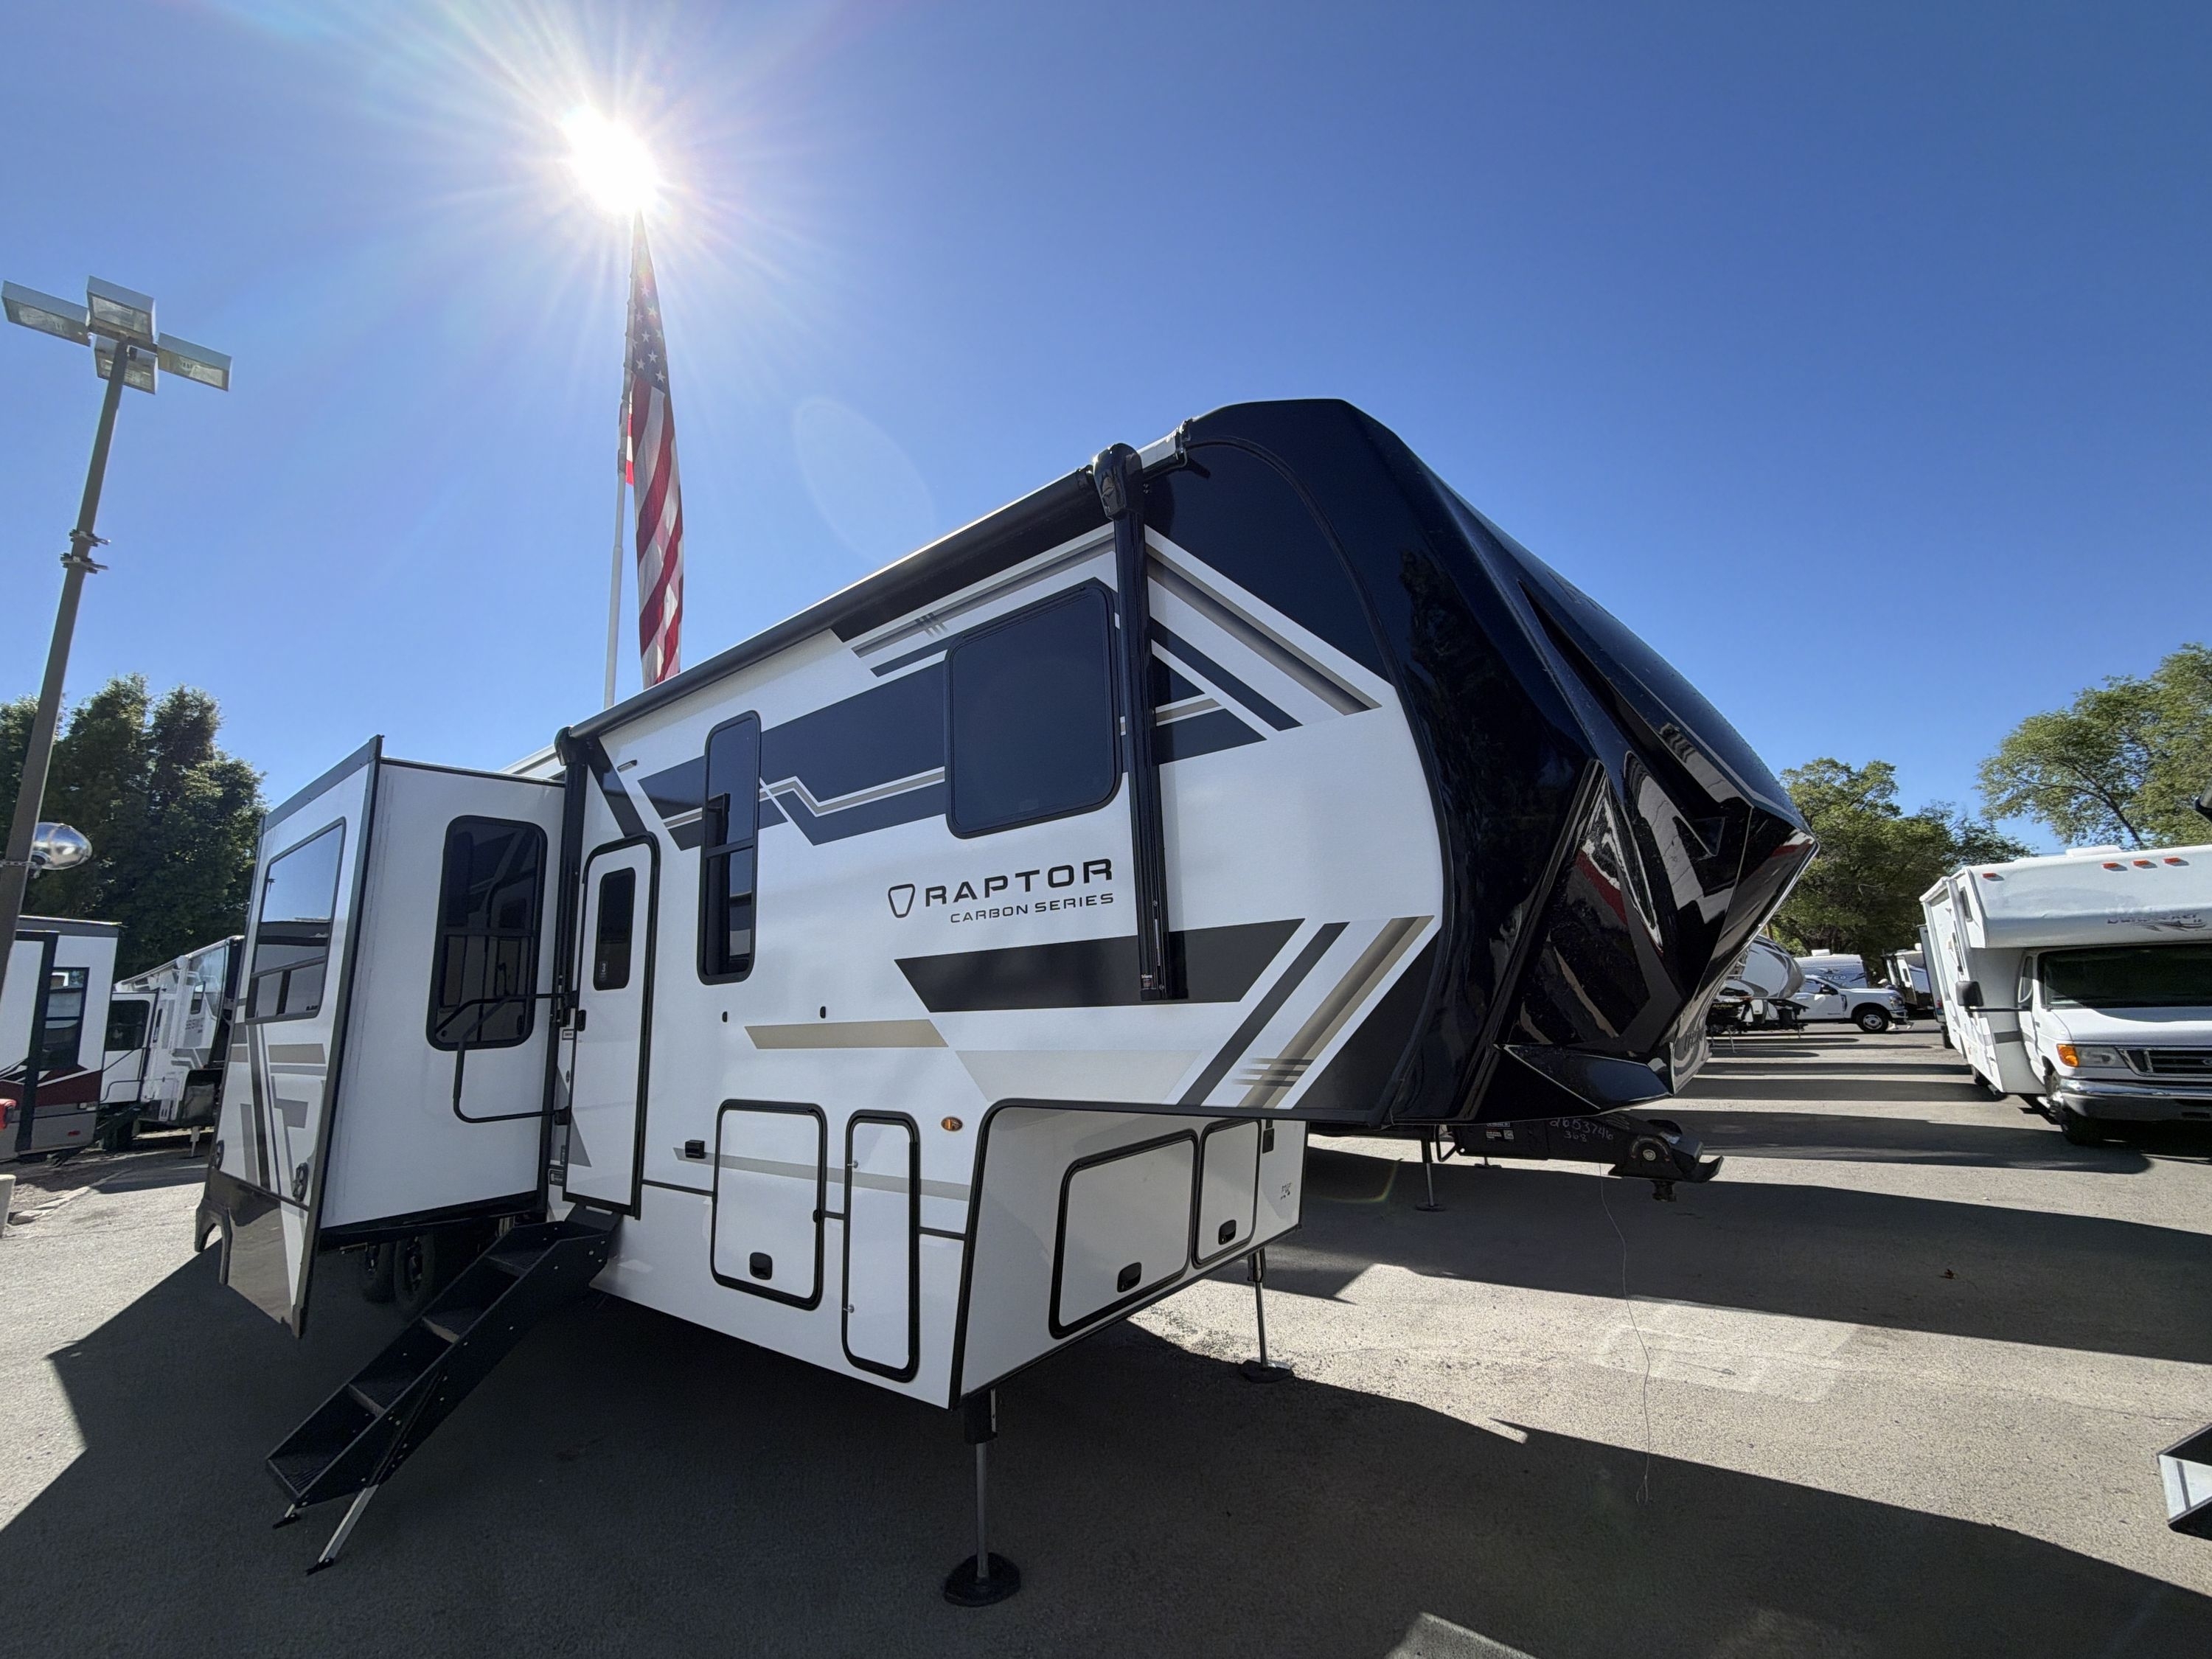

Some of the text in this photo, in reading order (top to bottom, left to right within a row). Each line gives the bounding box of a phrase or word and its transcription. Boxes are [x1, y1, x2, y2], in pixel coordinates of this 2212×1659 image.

[925, 858, 1113, 908] RAPTOR
[950, 892, 1115, 924] CARBON SERIES
